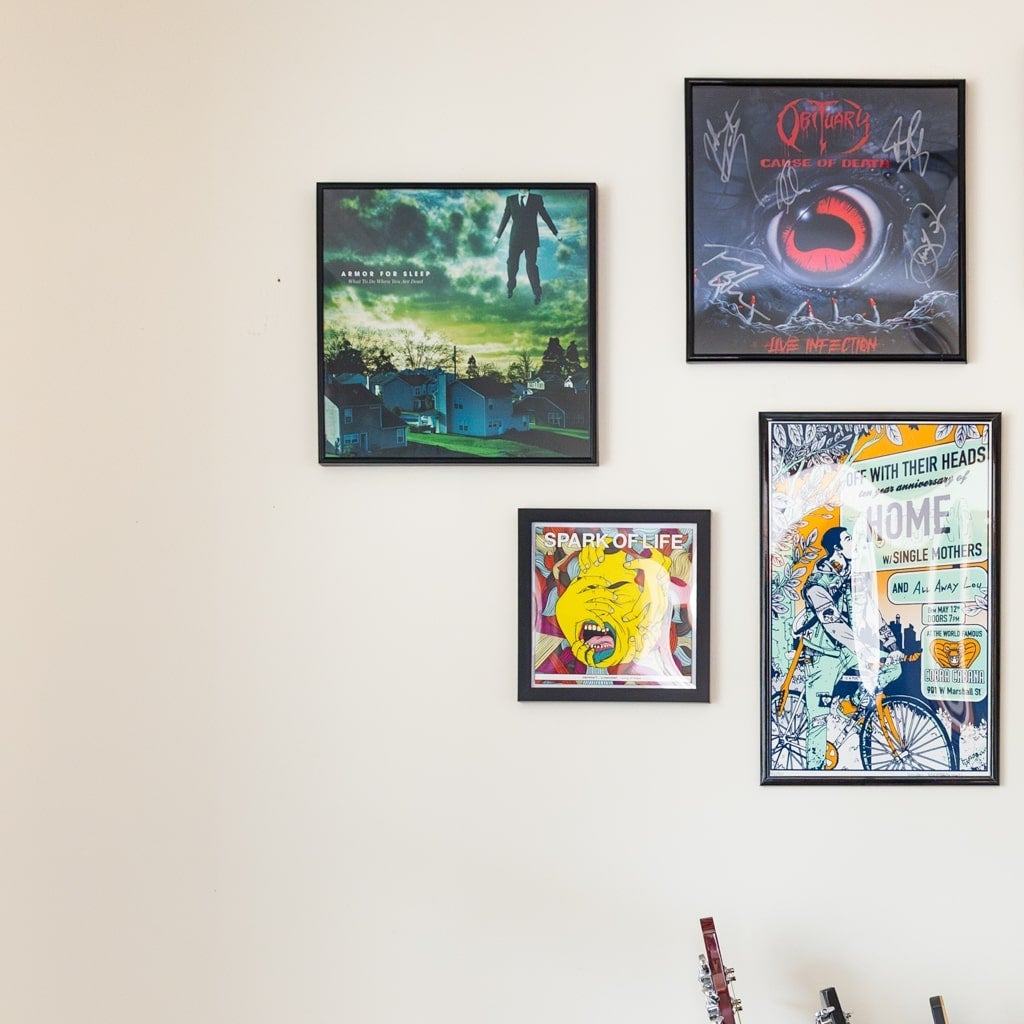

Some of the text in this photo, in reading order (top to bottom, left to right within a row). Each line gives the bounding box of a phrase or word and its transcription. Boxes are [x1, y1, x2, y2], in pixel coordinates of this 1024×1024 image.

[760, 159, 890, 168] CAUSE OF DEATH
[764, 335, 878, 353] LIVE INFECTION
[870, 463, 898, 482] WITH
[902, 455, 938, 477] THEIR
[942, 446, 986, 470] HEADS
[896, 475, 954, 492] anniversary
[956, 470, 970, 485] of
[867, 494, 951, 542] HOME
[543, 532, 683, 549] SPARK OF LIFE
[932, 543, 982, 560] MOTHERS
[892, 582, 909, 593] AND
[925, 669, 985, 684] COBRA CABANA
[939, 686, 946, 694] W
[947, 686, 973, 695] Marshall
